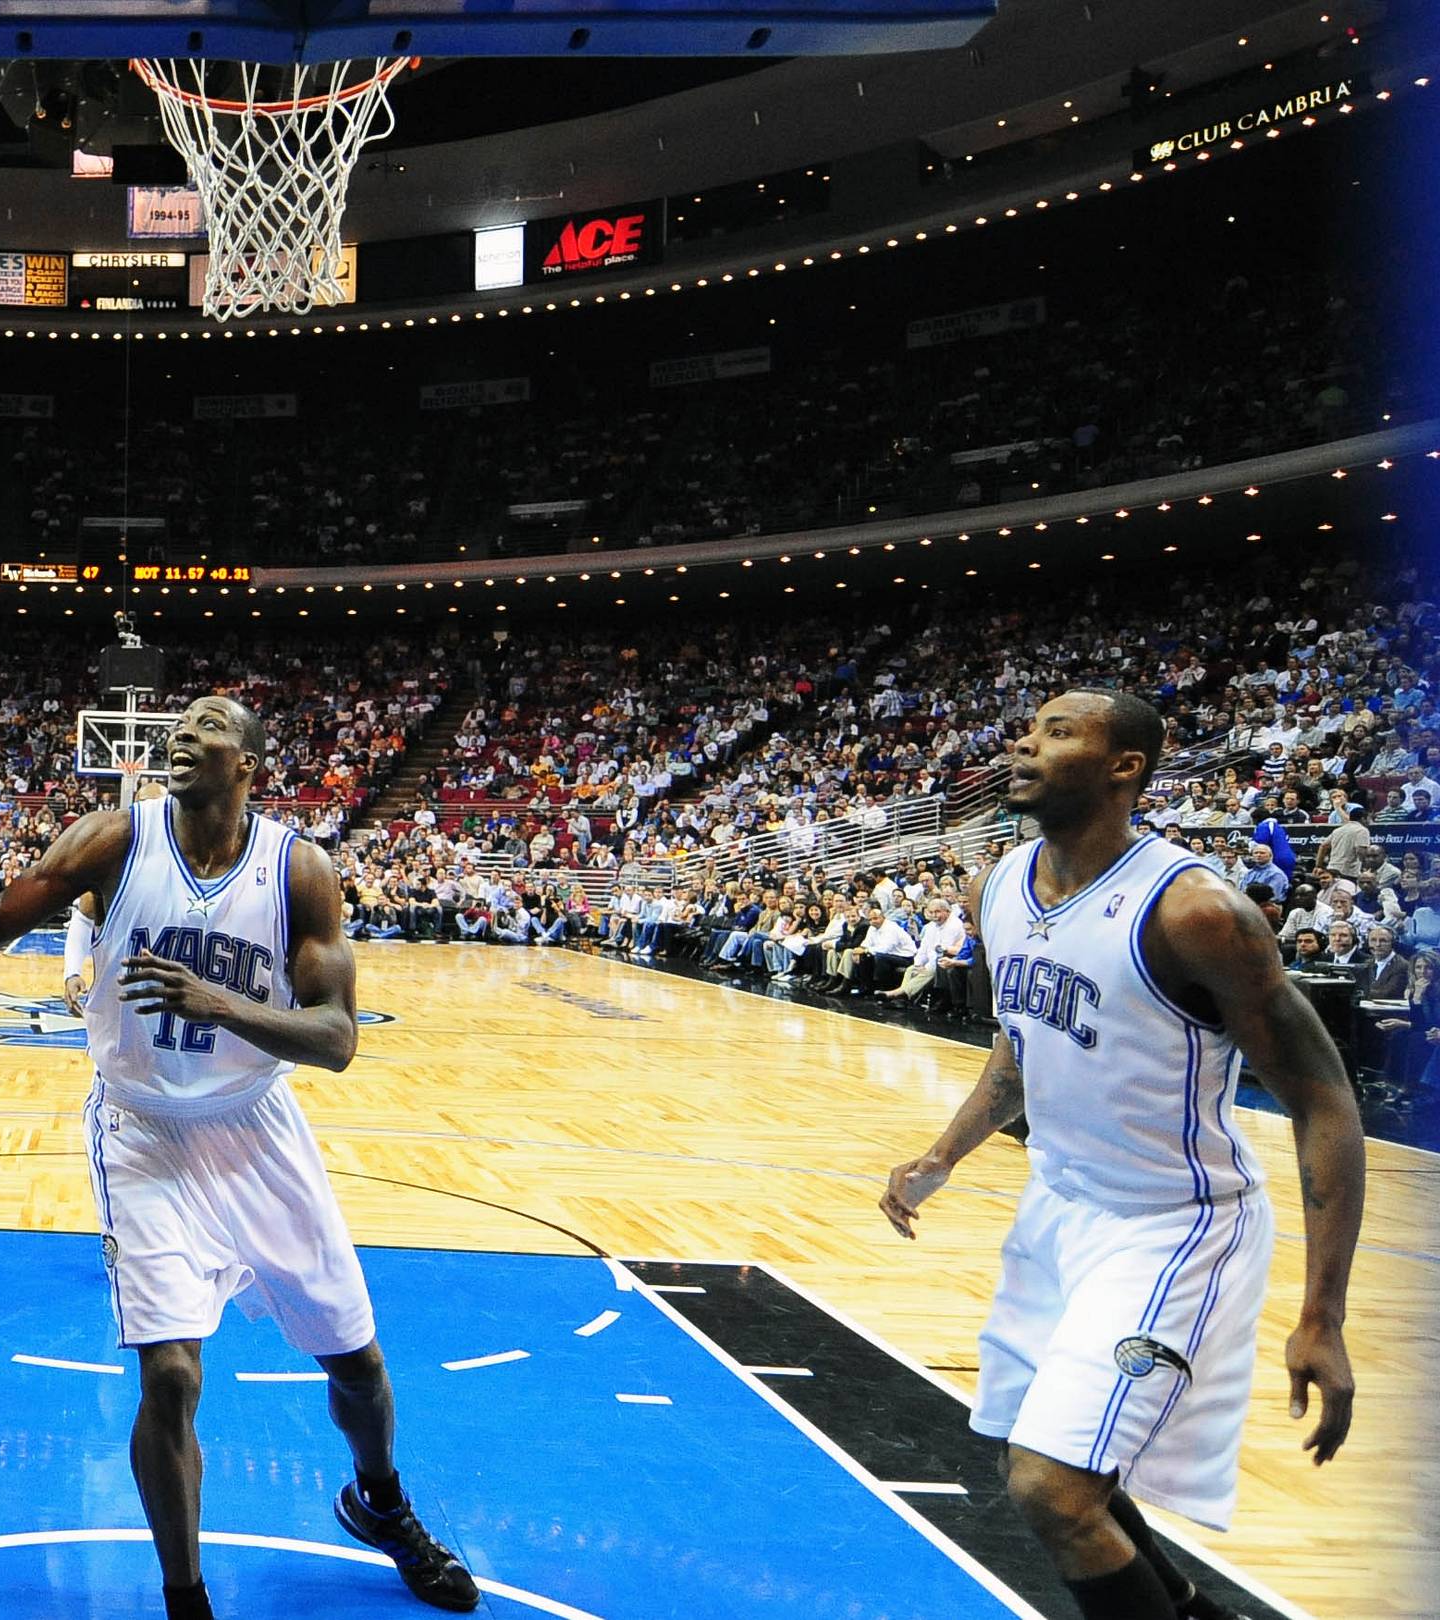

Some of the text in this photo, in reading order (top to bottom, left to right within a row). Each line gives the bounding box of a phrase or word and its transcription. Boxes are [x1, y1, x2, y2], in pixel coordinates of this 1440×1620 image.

[1178, 81, 1351, 151] CLUB CAMBRIA
[150, 210, 190, 221] 1994-95
[543, 214, 646, 267] ACE
[26, 255, 65, 270] WIN
[89, 255, 169, 266] CHRYSLER
[542, 265, 562, 275] The
[564, 259, 602, 272] helpful
[96, 298, 143, 310] FINLANDIA
[82, 566, 99, 579] 47
[165, 567, 205, 580] 11.57
[210, 567, 250, 580] +0.31
[126, 927, 273, 1004] MAGIC
[994, 954, 1102, 1050] AGIC
[153, 1003, 219, 1054] 12
